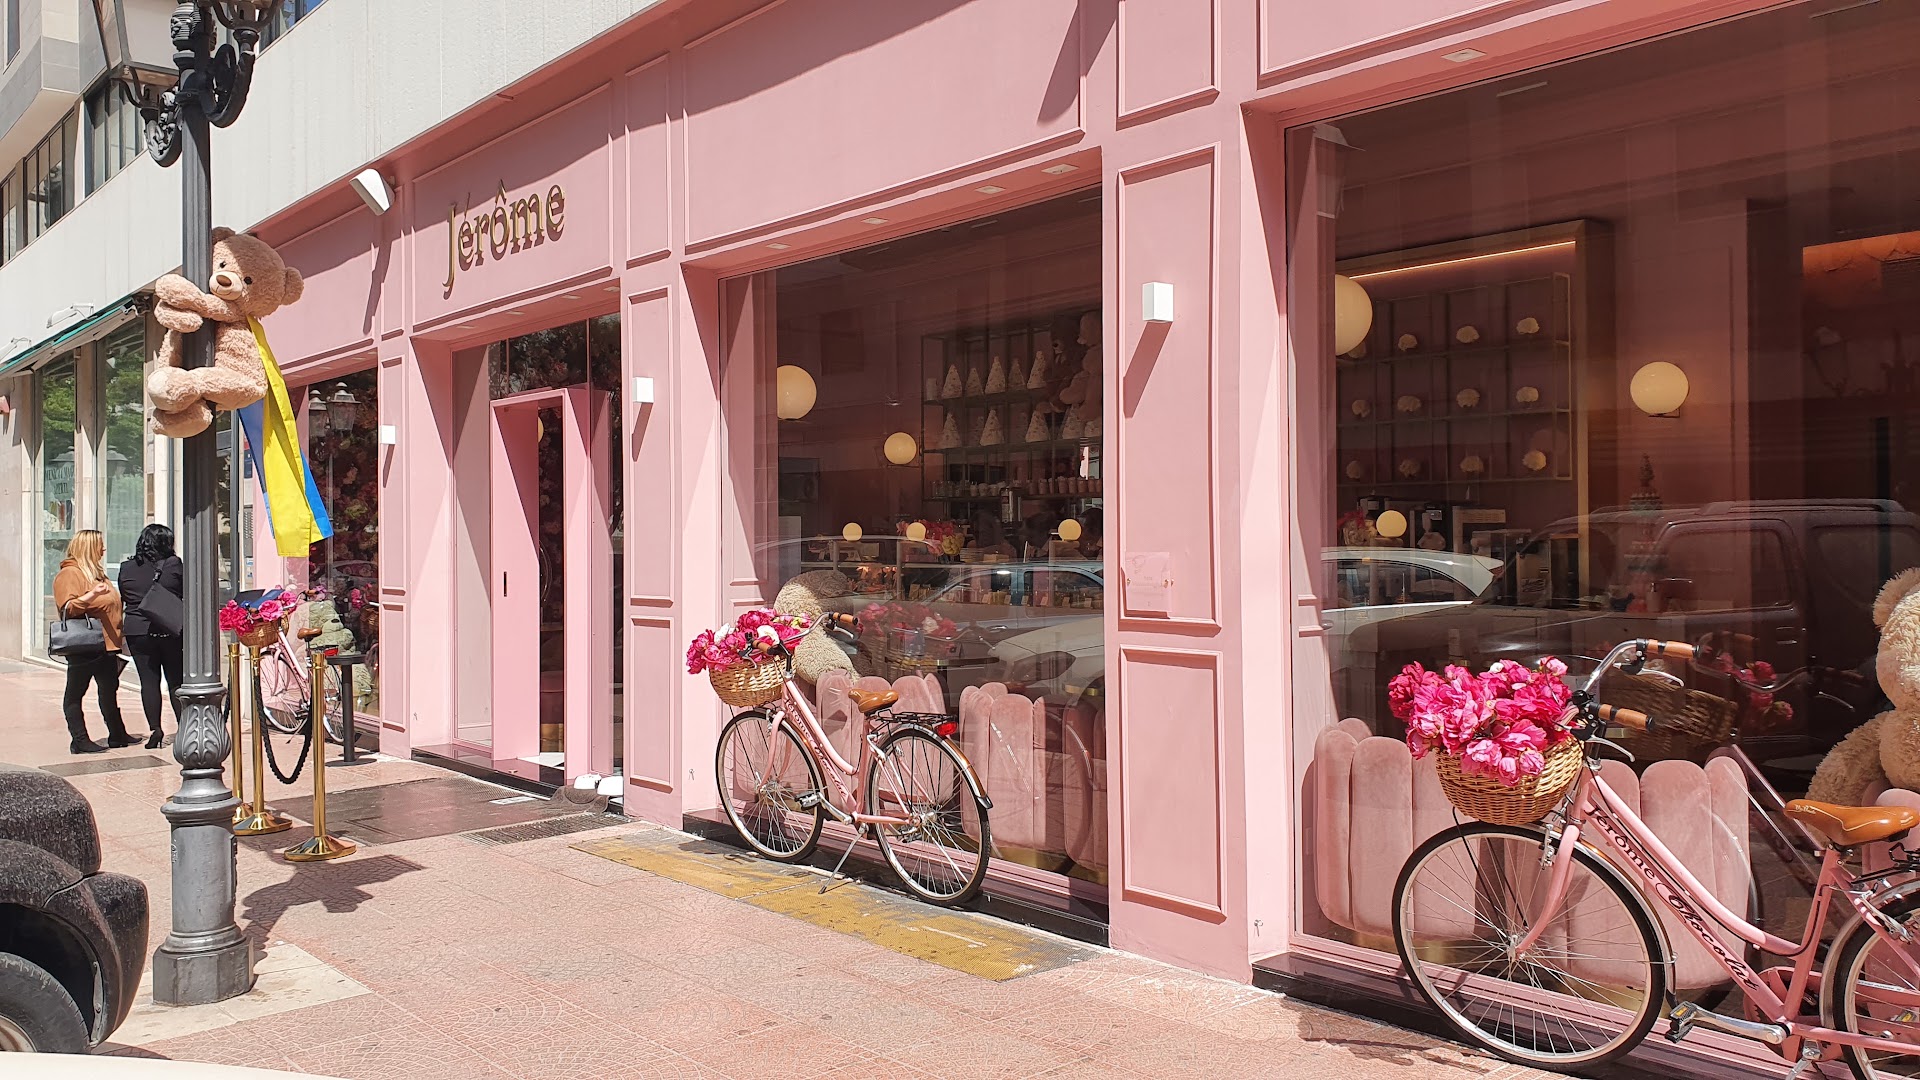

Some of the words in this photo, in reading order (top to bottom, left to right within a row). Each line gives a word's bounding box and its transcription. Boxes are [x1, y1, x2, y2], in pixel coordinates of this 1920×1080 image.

[442, 179, 566, 289] Jérôme
[1584, 804, 1656, 880] Jérôme
[1655, 882, 1760, 991] Chocolat
